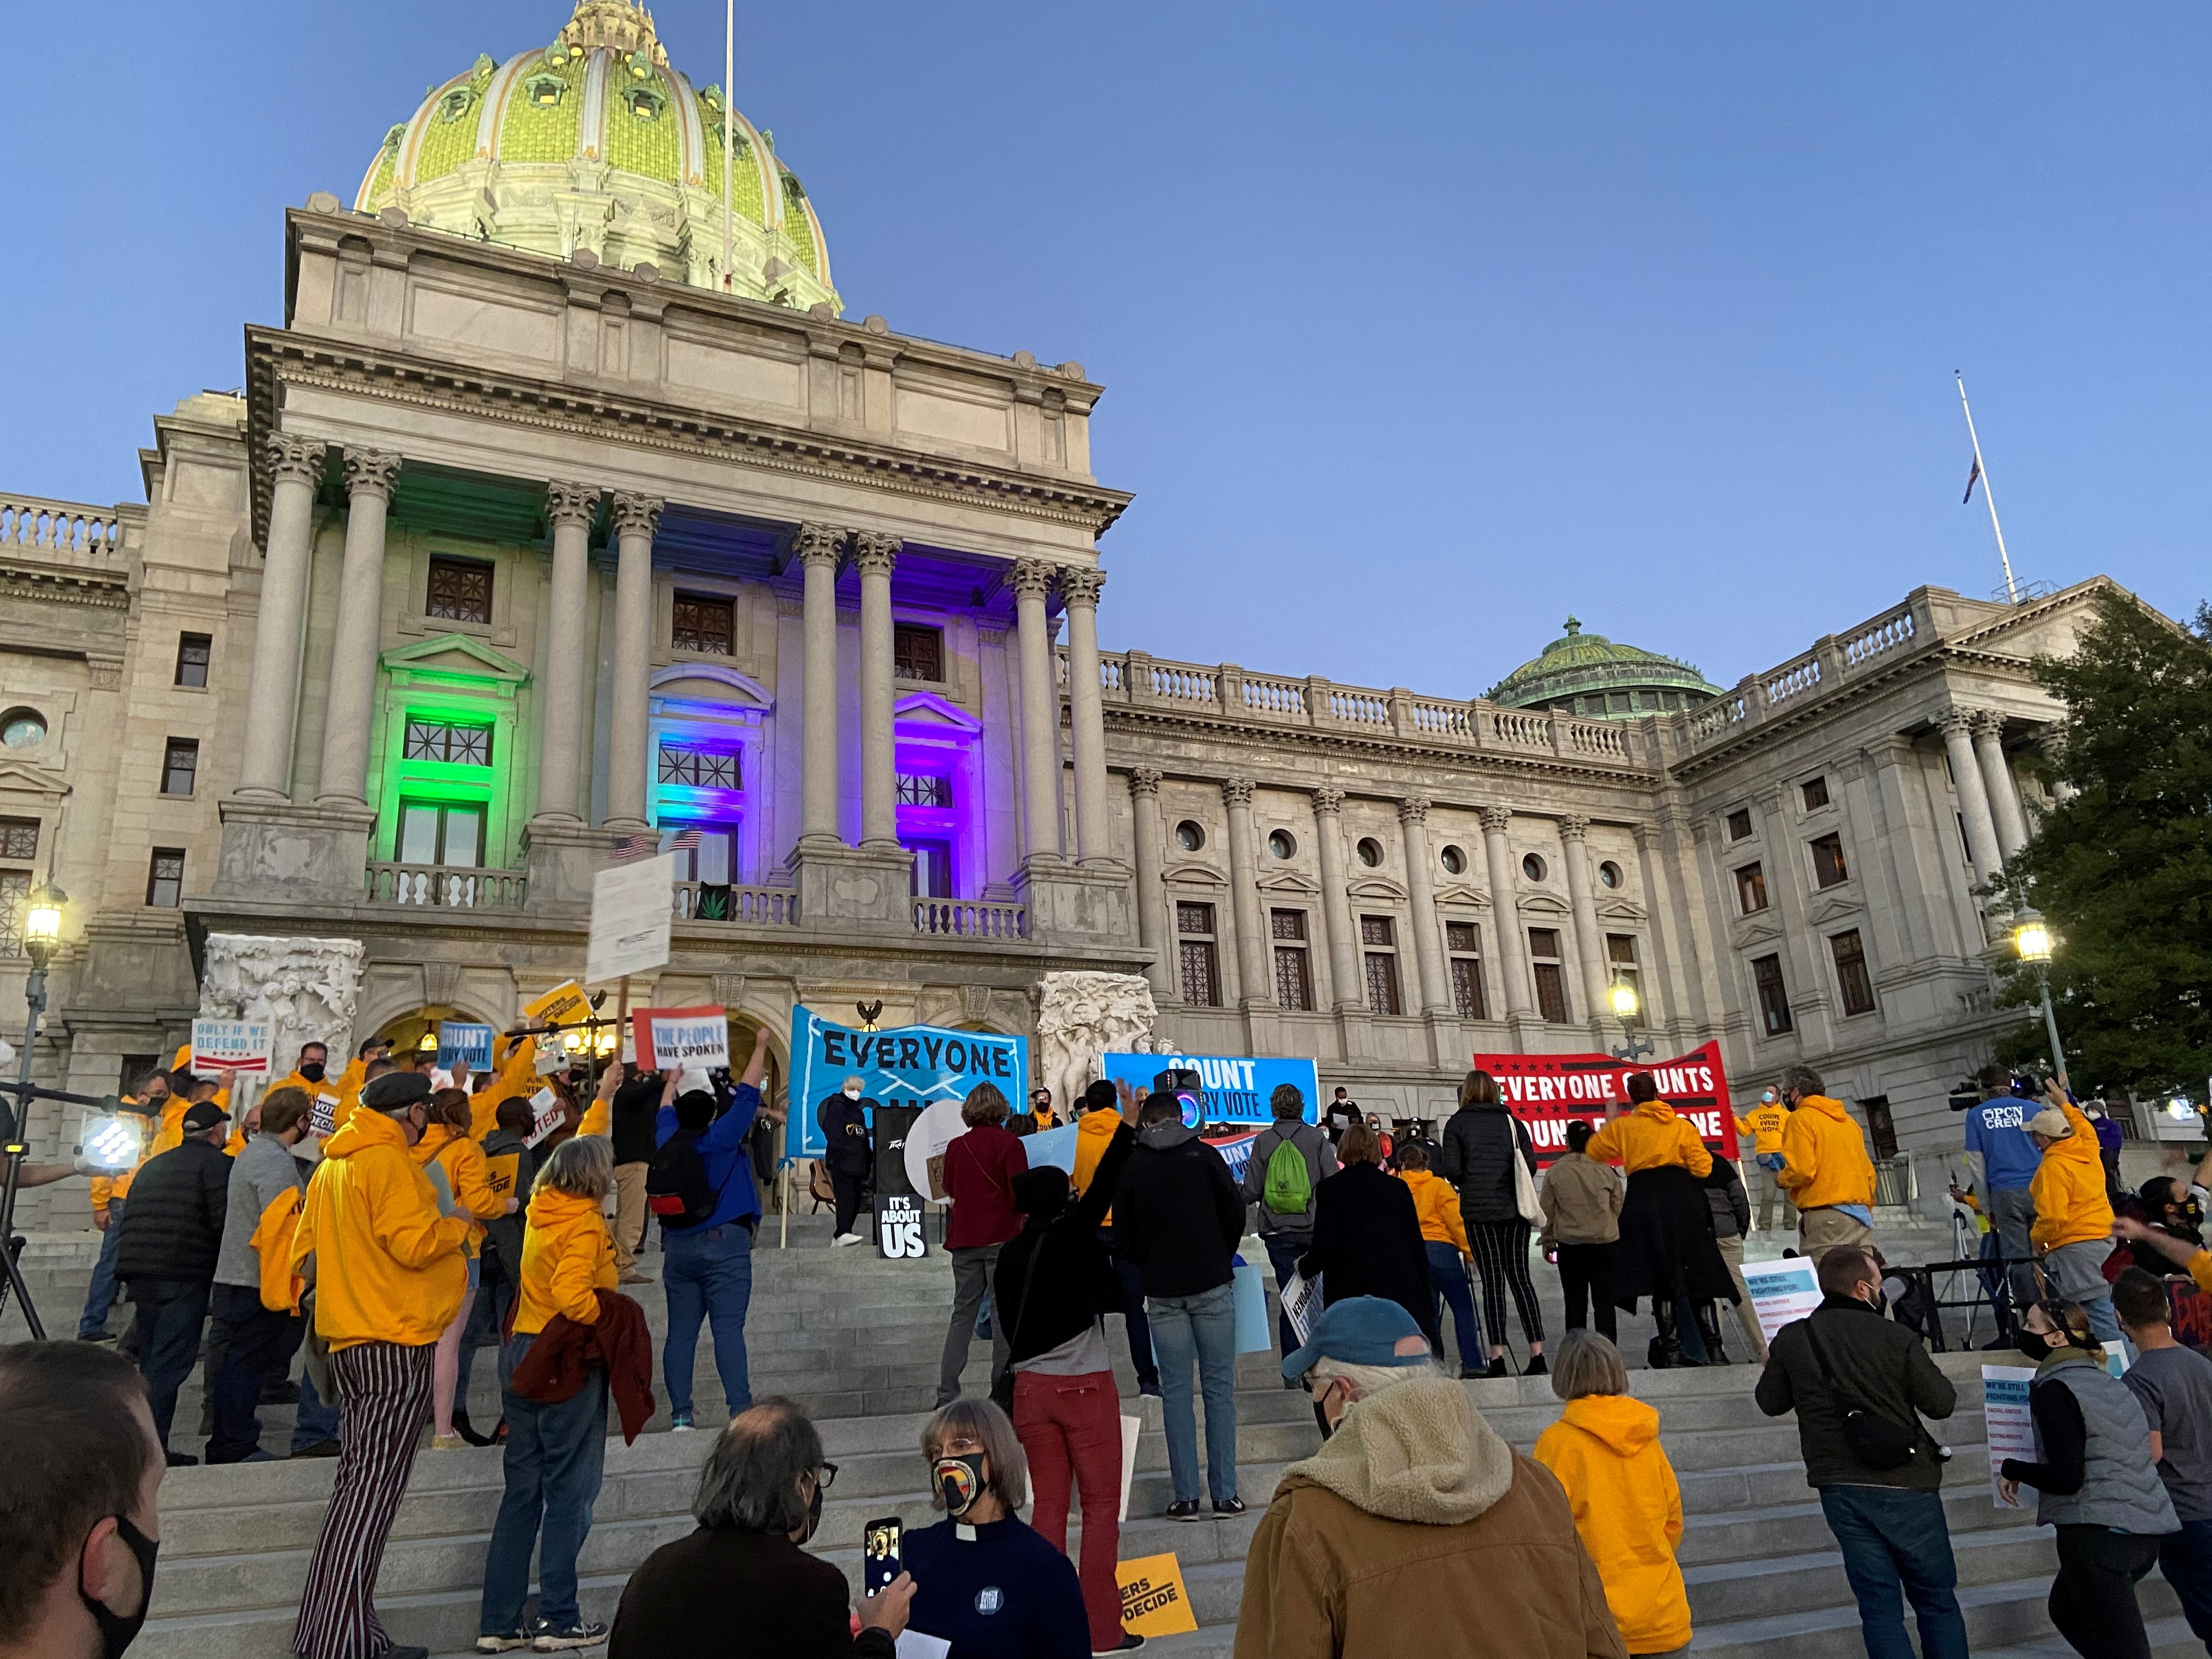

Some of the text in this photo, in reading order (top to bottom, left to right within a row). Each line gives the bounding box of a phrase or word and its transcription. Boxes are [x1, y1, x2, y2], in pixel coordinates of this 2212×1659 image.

[198, 1024, 268, 1037] ONLY IF WE
[654, 1025, 723, 1046] THE PEOPLE
[197, 1036, 267, 1050] DEFEND IT
[657, 1042, 725, 1058] HAVE SPOKEN
[462, 1047, 486, 1063] VOTE
[823, 1030, 1012, 1078] EVERYONE
[1493, 1074, 1616, 1102] EVERYONE
[1223, 1091, 1262, 1117] VOTE
[1993, 1106, 2023, 1119] PCN
[1986, 1116, 2023, 1130] CREW
[492, 1179, 511, 1194] IDE
[889, 1197, 911, 1210] IT'S
[881, 1210, 921, 1223] ABOUT
[881, 1222, 925, 1259] US
[1751, 1285, 1783, 1296] FIGHTING
[1293, 1286, 1313, 1320] SPOKEN
[1985, 1381, 2026, 1391] WE'RE STILL
[1986, 1393, 2018, 1402] FIGHTING
[1119, 1578, 1150, 1600] ERS
[1123, 1588, 1178, 1621] DECIDE
